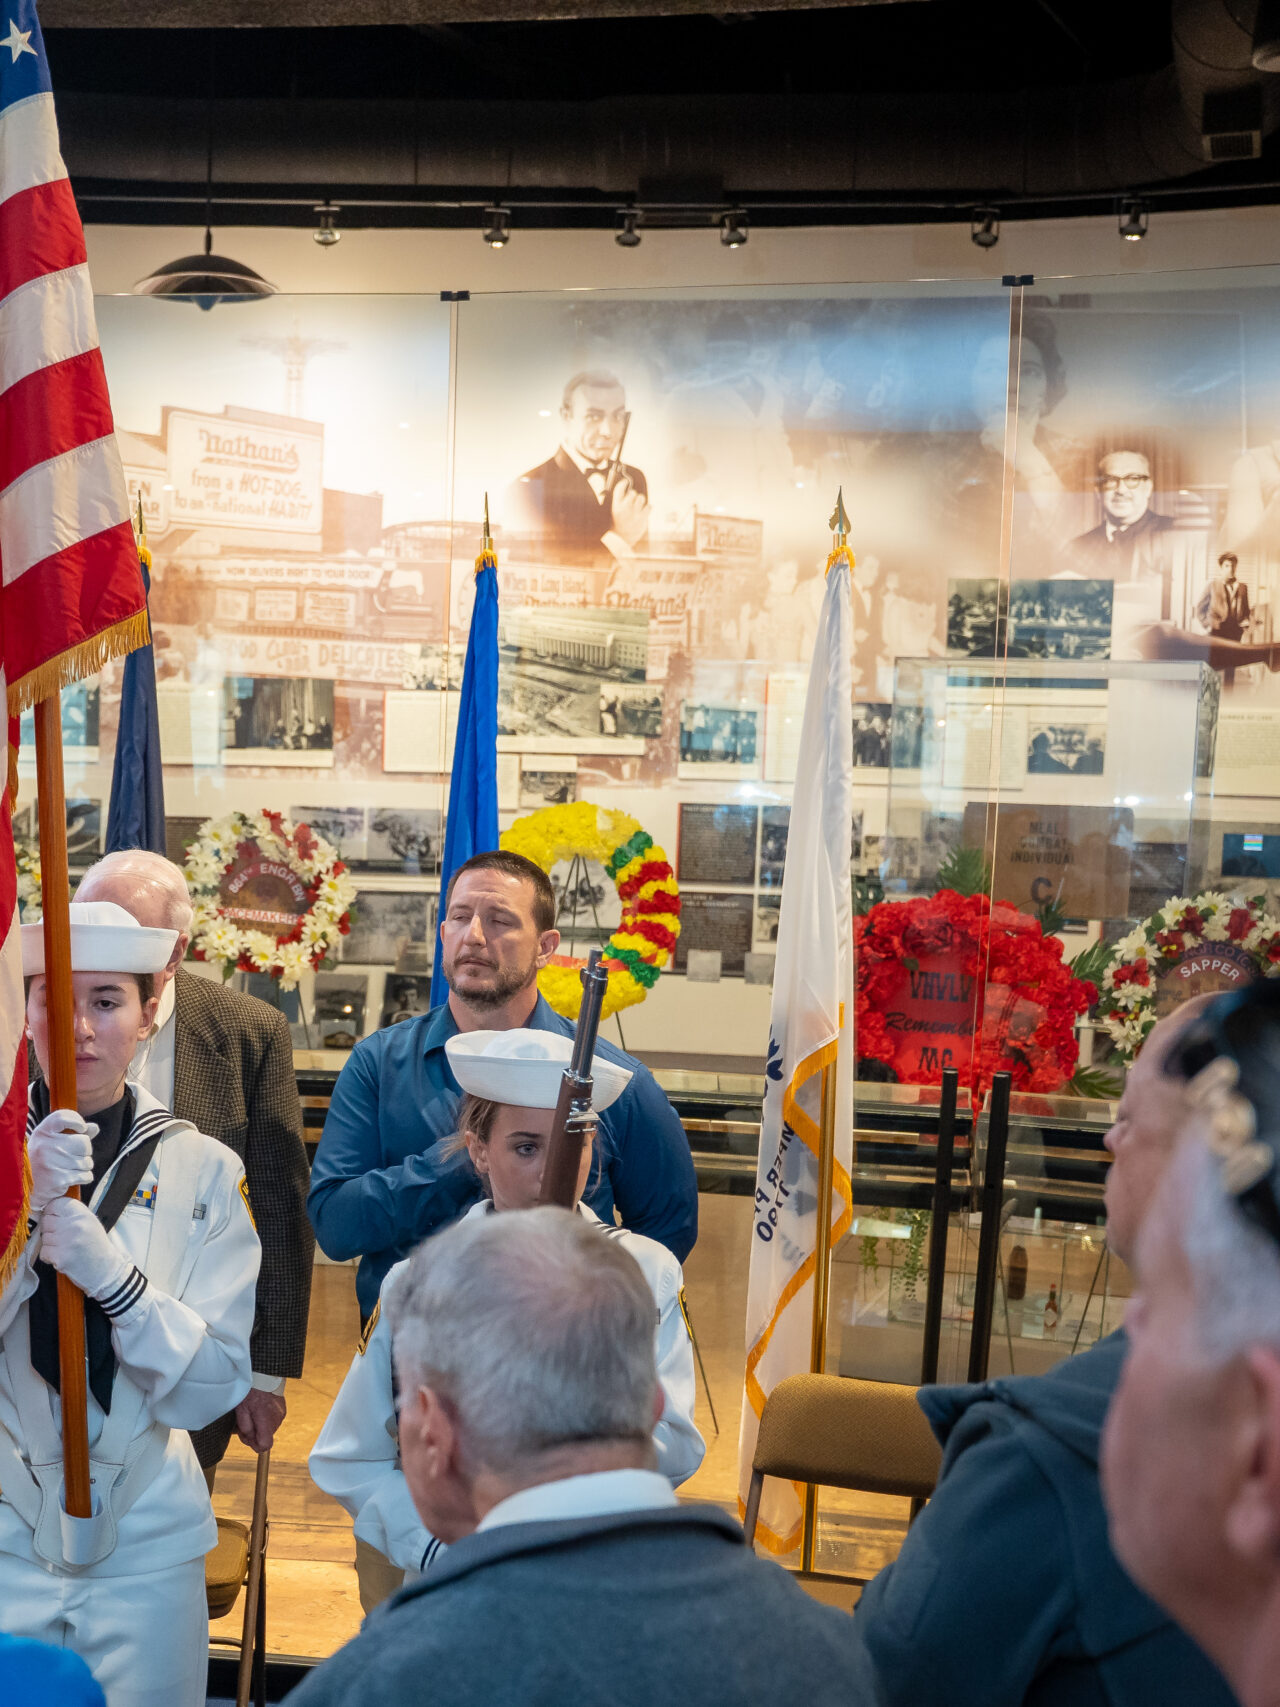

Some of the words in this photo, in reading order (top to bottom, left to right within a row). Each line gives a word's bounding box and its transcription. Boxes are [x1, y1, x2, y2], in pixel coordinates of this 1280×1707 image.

[260, 862, 297, 885] ENGR
[291, 883, 307, 902] BN
[1030, 876, 1053, 905] C
[1180, 958, 1240, 982] SAPPER
